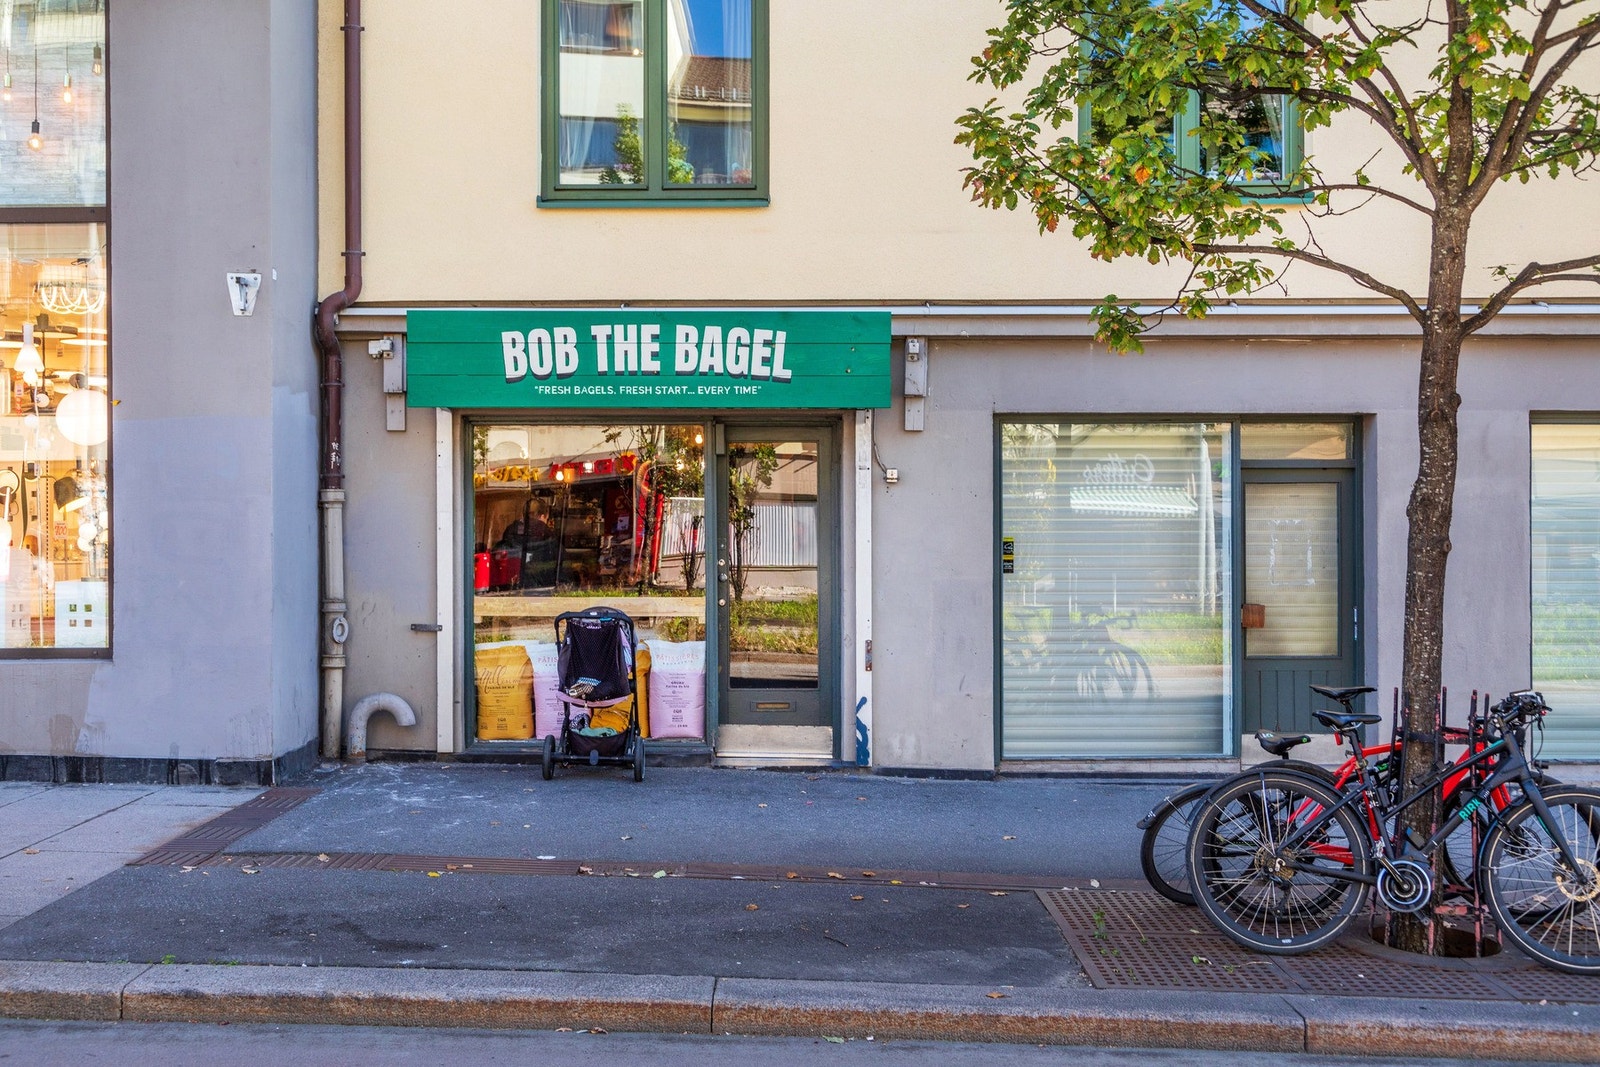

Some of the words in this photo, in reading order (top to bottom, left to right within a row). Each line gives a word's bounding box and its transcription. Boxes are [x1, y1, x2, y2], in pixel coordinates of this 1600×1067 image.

[501, 326, 580, 383] BOB
[591, 324, 661, 376] THE
[674, 324, 793, 383] BAGEL
[534, 385, 571, 395] "FRESH
[619, 385, 653, 395] FRESH
[655, 385, 695, 395] START...
[698, 385, 731, 395] EVERY
[733, 385, 762, 395] TIME"
